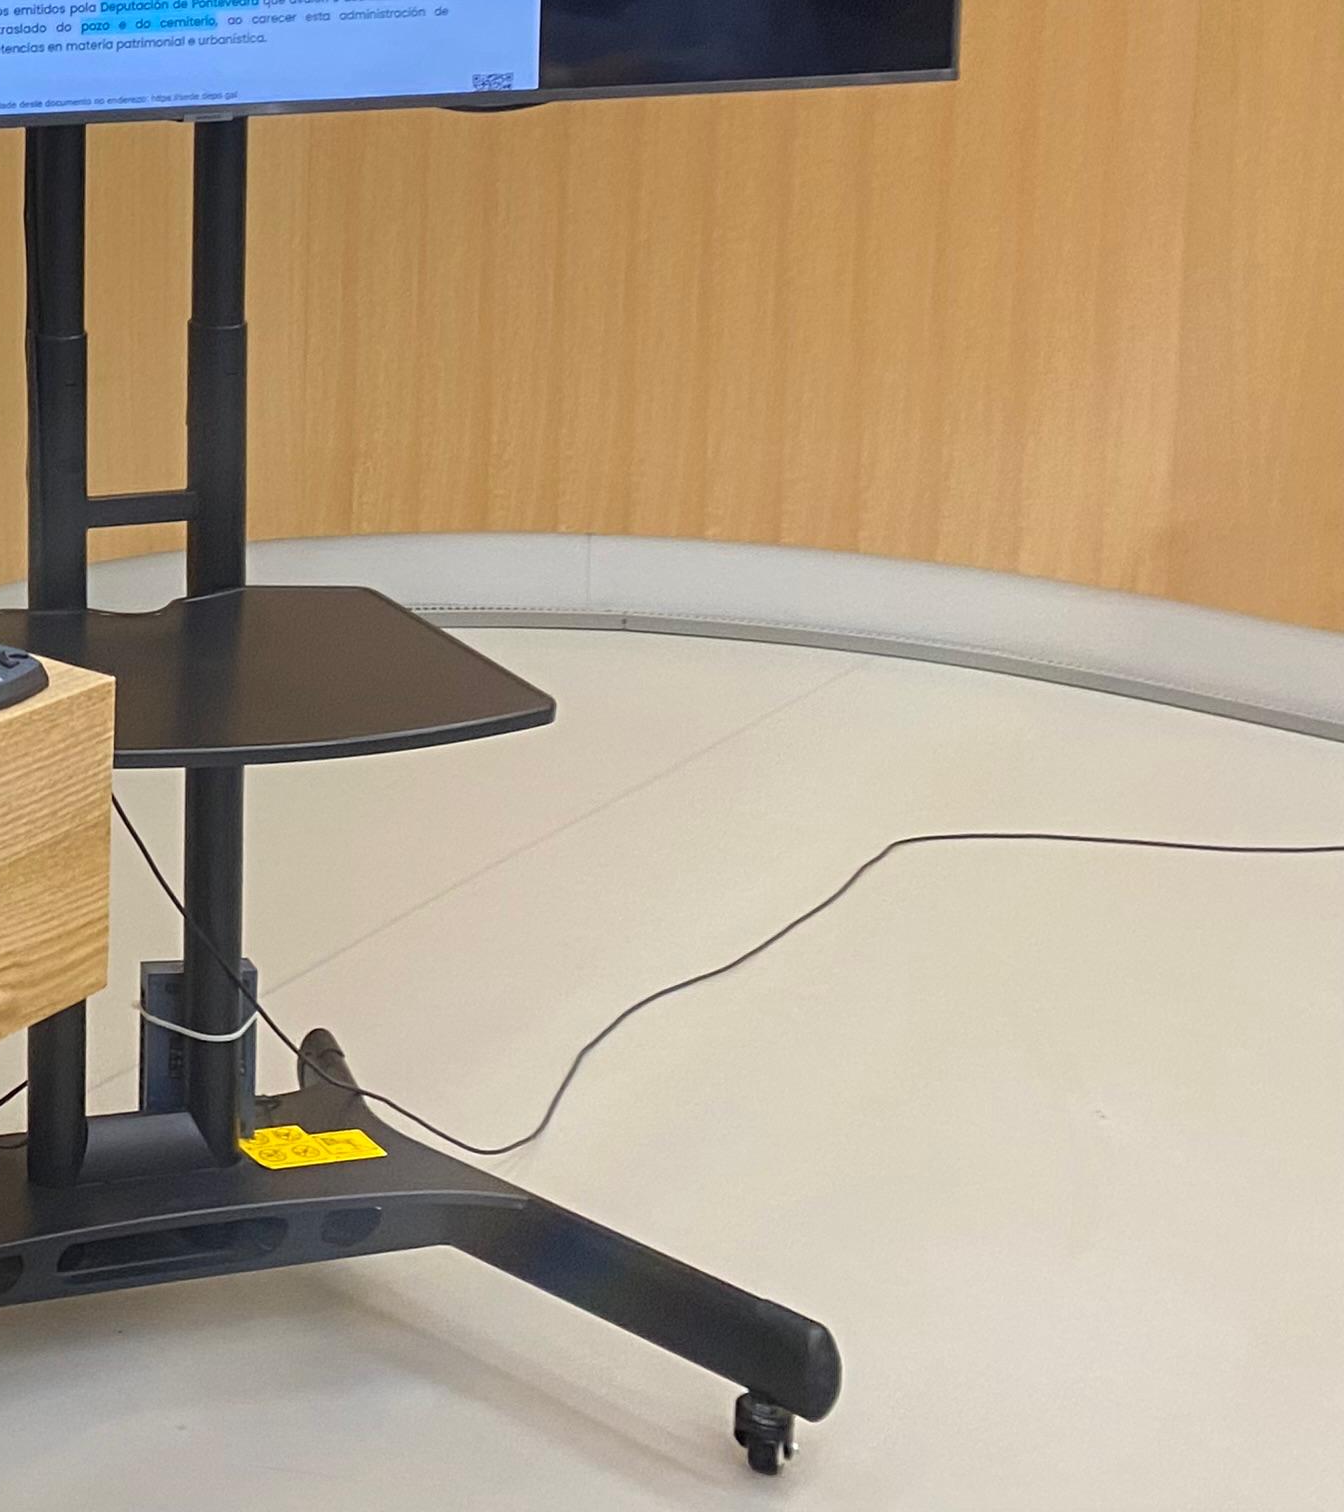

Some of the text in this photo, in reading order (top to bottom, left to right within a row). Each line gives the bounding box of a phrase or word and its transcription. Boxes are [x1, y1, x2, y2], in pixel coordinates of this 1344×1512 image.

[12, 2, 66, 16] emitidos
[250, 14, 297, 24] carecer
[65, 37, 114, 51] materia
[115, 34, 185, 52] patrimonial
